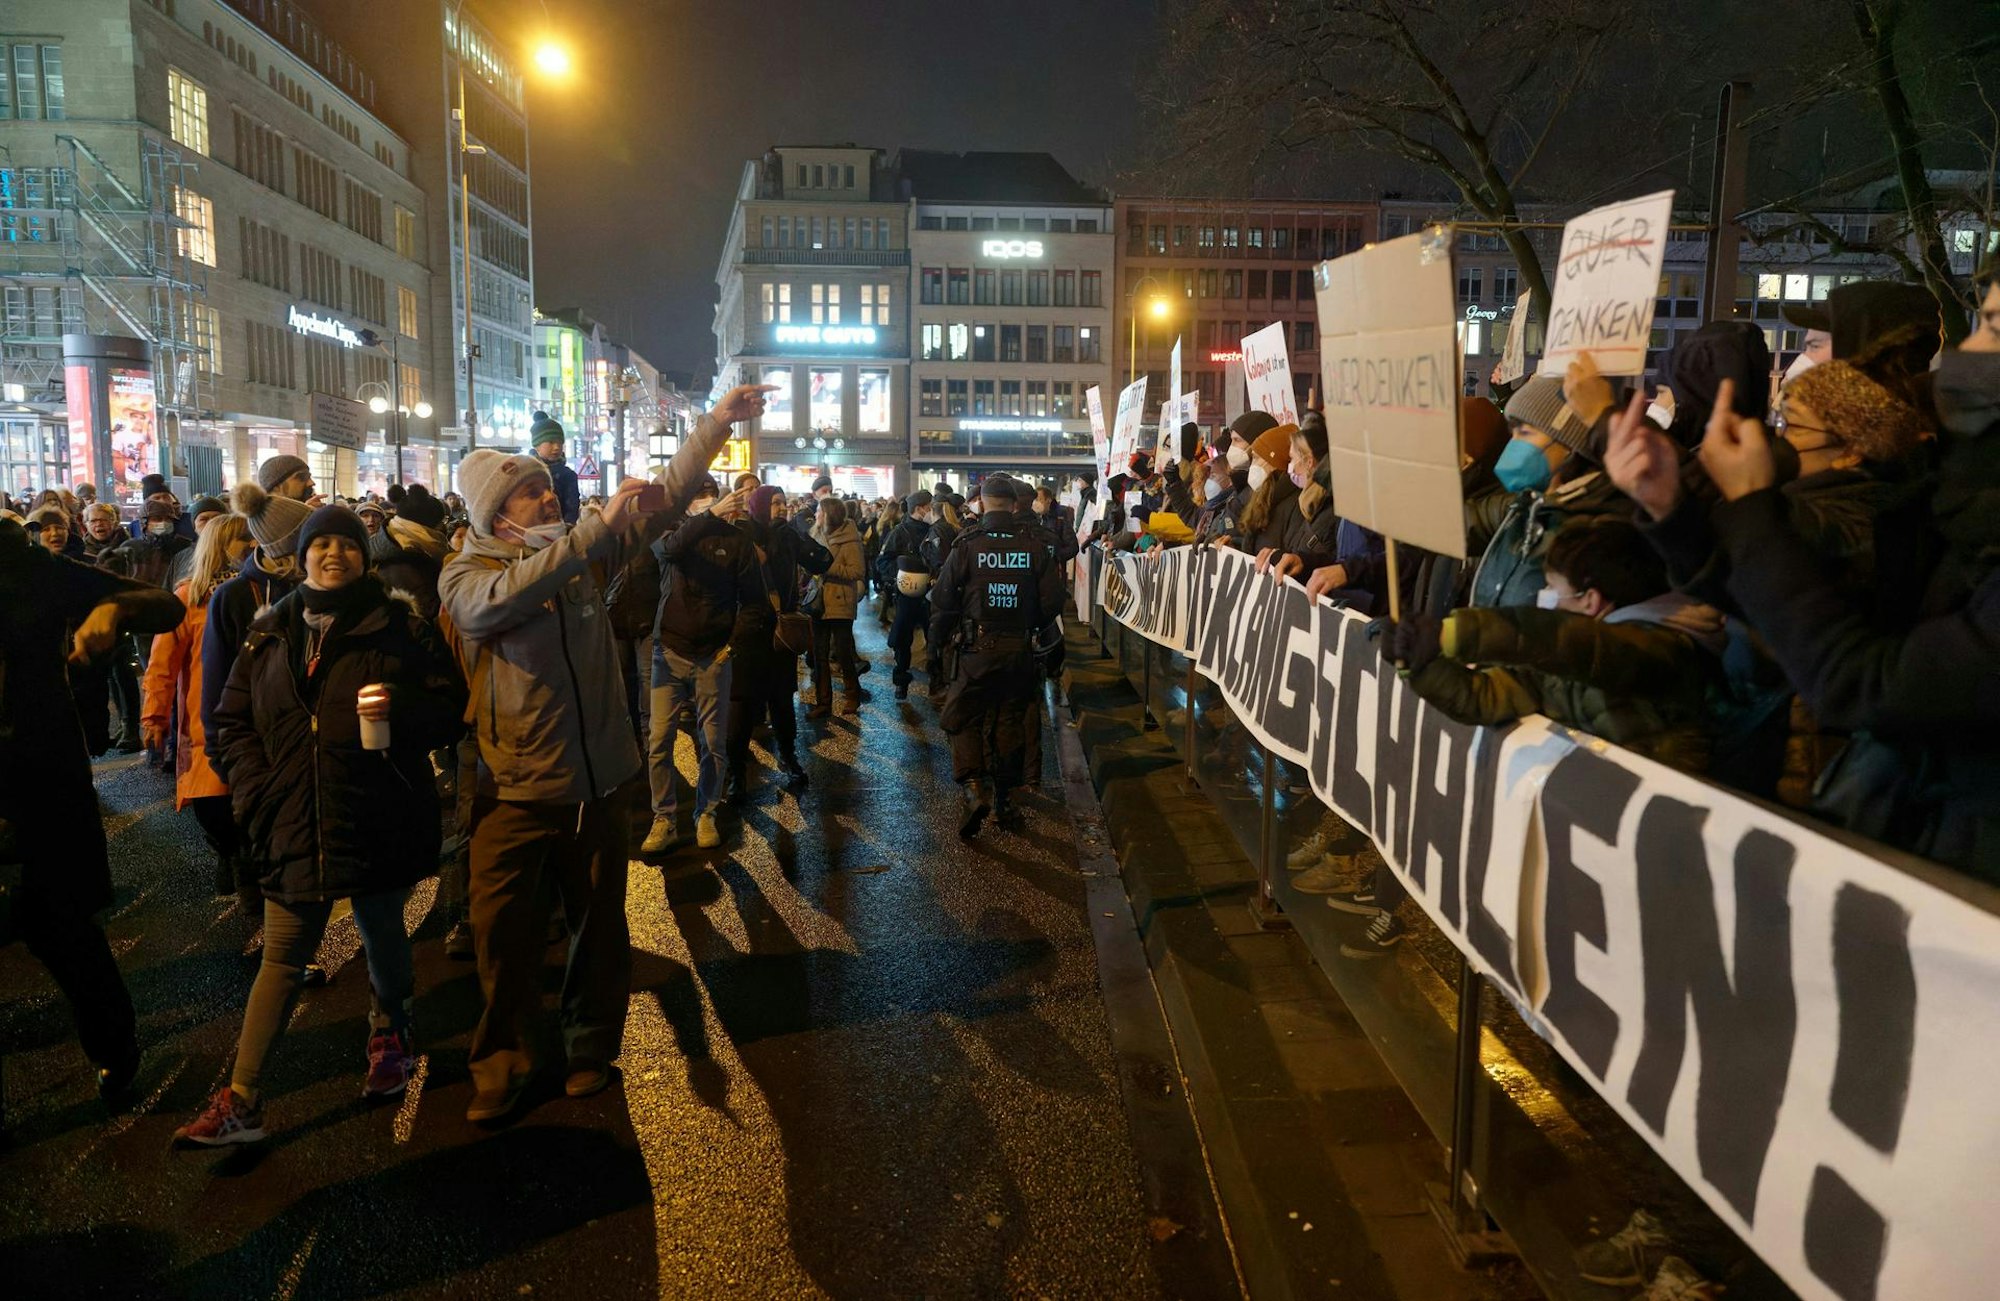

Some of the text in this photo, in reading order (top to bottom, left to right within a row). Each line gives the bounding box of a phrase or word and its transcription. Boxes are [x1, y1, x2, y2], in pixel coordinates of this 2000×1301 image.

[983, 240, 1043, 259] IQOS
[1564, 217, 1652, 281] QUER
[1466, 305, 1497, 320] Georg
[776, 326, 876, 344] FIVE GUYS
[978, 552, 1030, 569] POLIZEI
[988, 583, 1018, 596] NRW
[988, 596, 1018, 609] 31131
